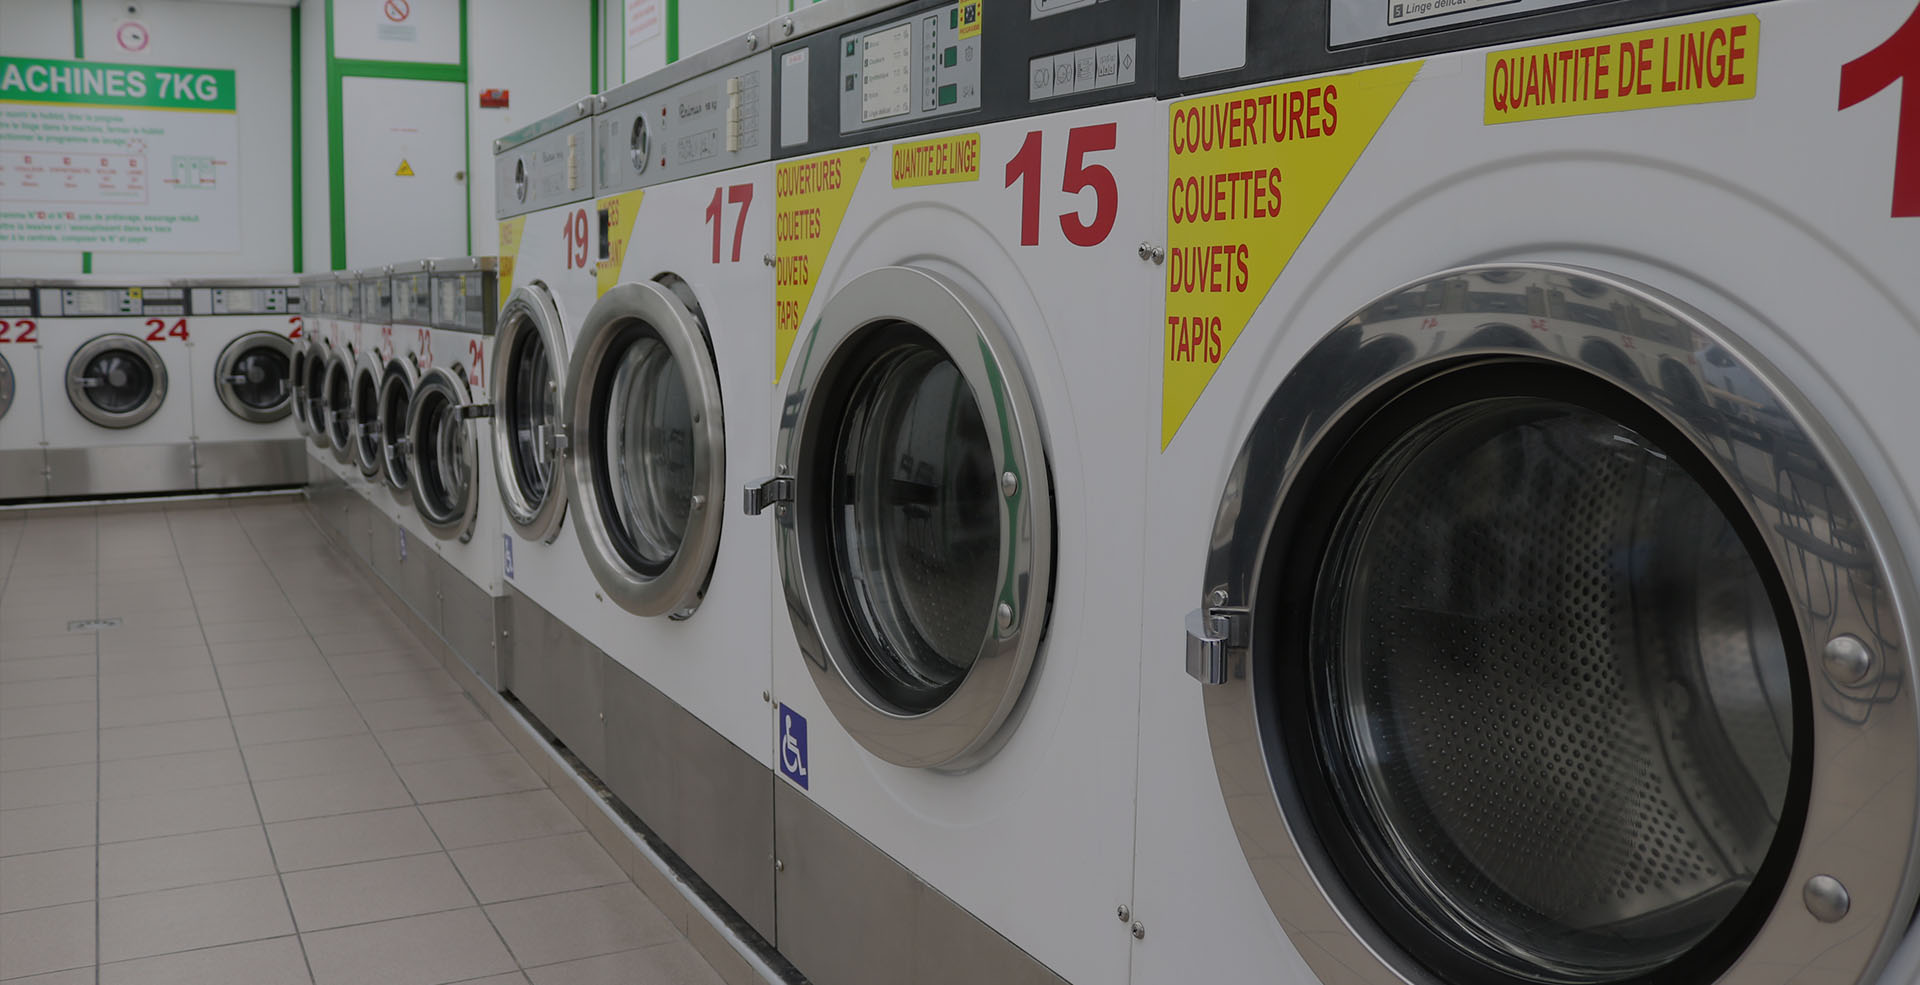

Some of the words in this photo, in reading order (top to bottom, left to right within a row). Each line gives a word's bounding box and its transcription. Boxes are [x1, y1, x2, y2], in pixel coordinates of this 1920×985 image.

[1406, 2, 1432, 14] Linge
[0, 64, 147, 98] ACHINES
[155, 72, 218, 101] 7KG
[1492, 44, 1612, 113] QUANTITE
[1617, 38, 1654, 97] DE
[1661, 25, 1748, 93] LINGE
[1173, 84, 1338, 155] COUVERTURES
[777, 157, 842, 198] COUVERTURES
[894, 146, 934, 181] QUANTITE
[936, 143, 948, 175] DE
[949, 139, 977, 174] LINGE
[1005, 122, 1118, 247] 15
[1172, 167, 1282, 224] COUETTES
[563, 208, 588, 270] 19
[705, 183, 754, 264] 17
[777, 207, 821, 242] COUETTES
[777, 254, 809, 286] DUVETS
[1170, 243, 1249, 294] DUVETS
[145, 318, 189, 341] 24
[777, 300, 799, 331] TAPIS
[417, 327, 433, 368] 23
[468, 329, 485, 388] 21
[1168, 315, 1222, 364] TAPIS
